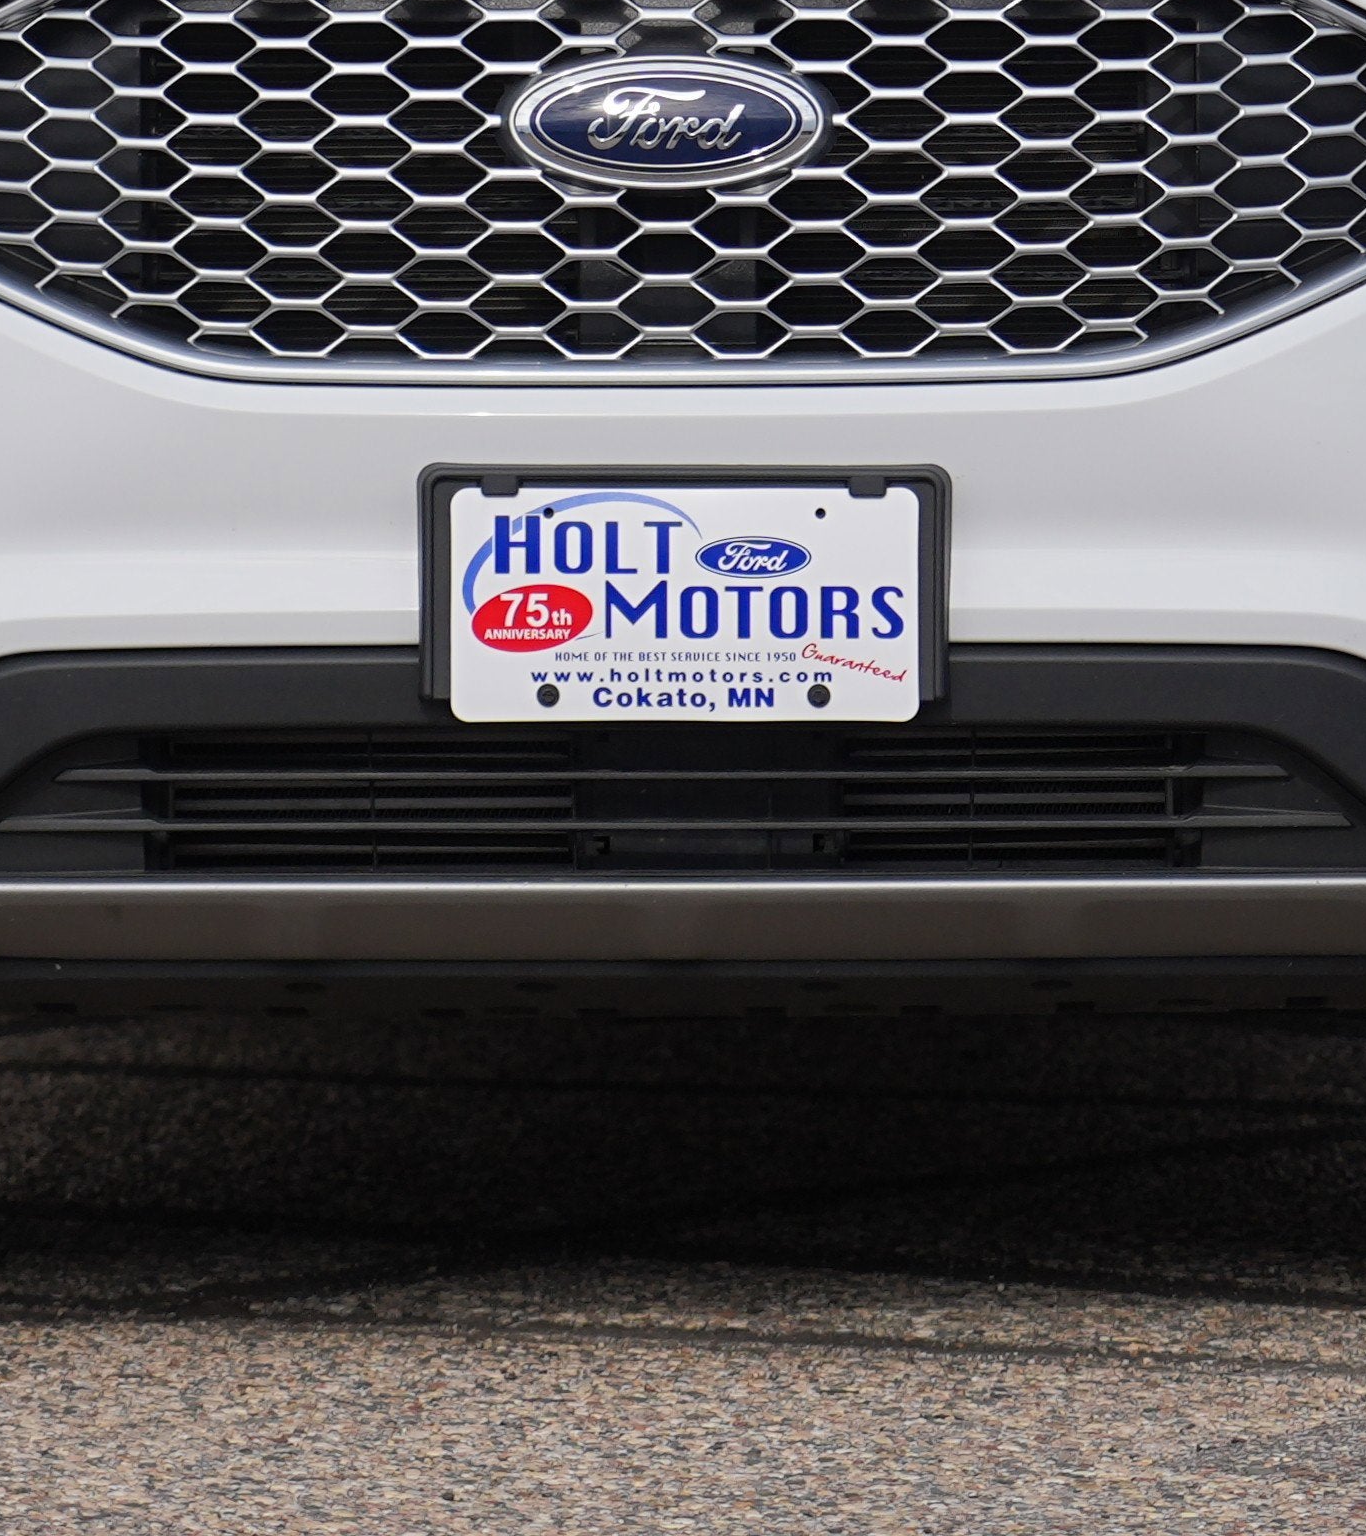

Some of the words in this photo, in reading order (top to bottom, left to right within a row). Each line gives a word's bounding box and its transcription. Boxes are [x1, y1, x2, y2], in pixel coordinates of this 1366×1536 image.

[587, 86, 746, 151] Ford
[493, 515, 683, 575] HOLT
[717, 540, 789, 573] Ford
[499, 592, 573, 628] 75th
[604, 579, 906, 640] MOTORS
[483, 628, 571, 641] ANNIVERSARY
[554, 651, 589, 662] HOME
[594, 651, 608, 662] OF
[612, 651, 634, 662] THE
[638, 651, 667, 662] BEST
[671, 651, 721, 662] SERVICE
[725, 651, 761, 662] SINCE
[766, 651, 797, 662] 1950
[801, 642, 908, 683] Guaranteed
[530, 667, 833, 683] www.holtmotors.com
[592, 686, 717, 713] Cokato,
[727, 687, 775, 708] MN
